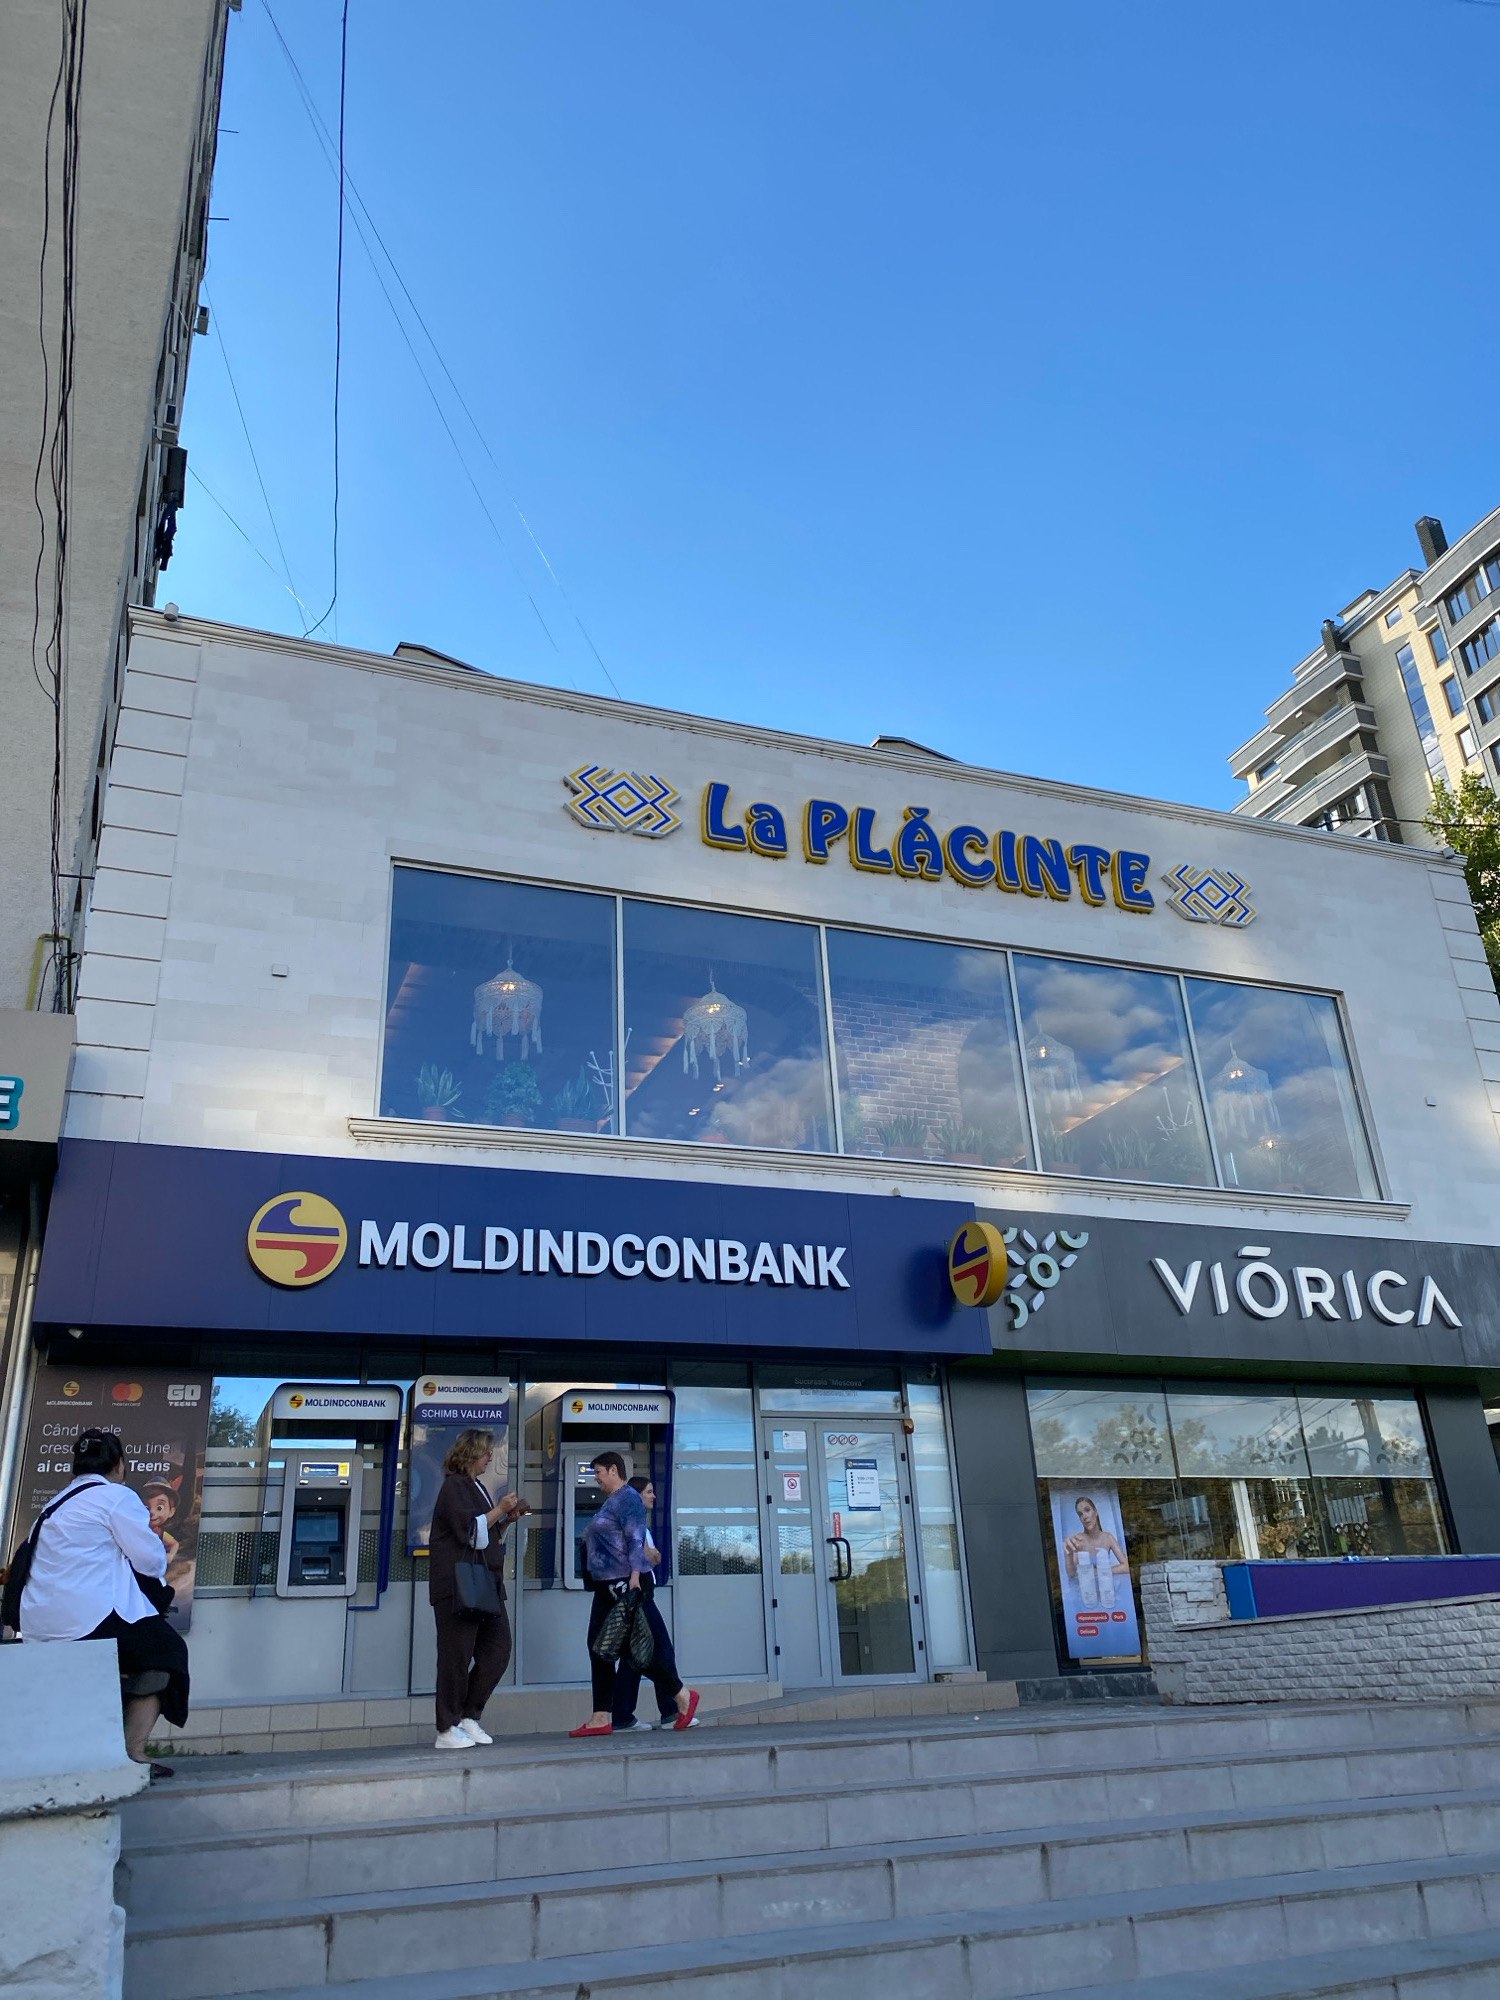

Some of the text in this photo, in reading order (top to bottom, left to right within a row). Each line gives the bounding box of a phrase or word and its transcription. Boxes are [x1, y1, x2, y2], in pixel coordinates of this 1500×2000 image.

[702, 779, 1157, 915] La PLĂCINTE
[357, 1219, 852, 1290] MOLDINDCONBANK
[167, 1384, 202, 1401] GO
[437, 1385, 503, 1395] MOLDINDCONBANK
[304, 1398, 387, 1409] MOLDINDCONBANK
[587, 1403, 660, 1413] MOLDINDCONBANK
[421, 1408, 503, 1420] SCHIMB VALUTAR
[42, 1423, 79, 1437] Când
[125, 1444, 142, 1454] cu
[37, 1460, 50, 1473] ai
[128, 1459, 171, 1473] Teens
